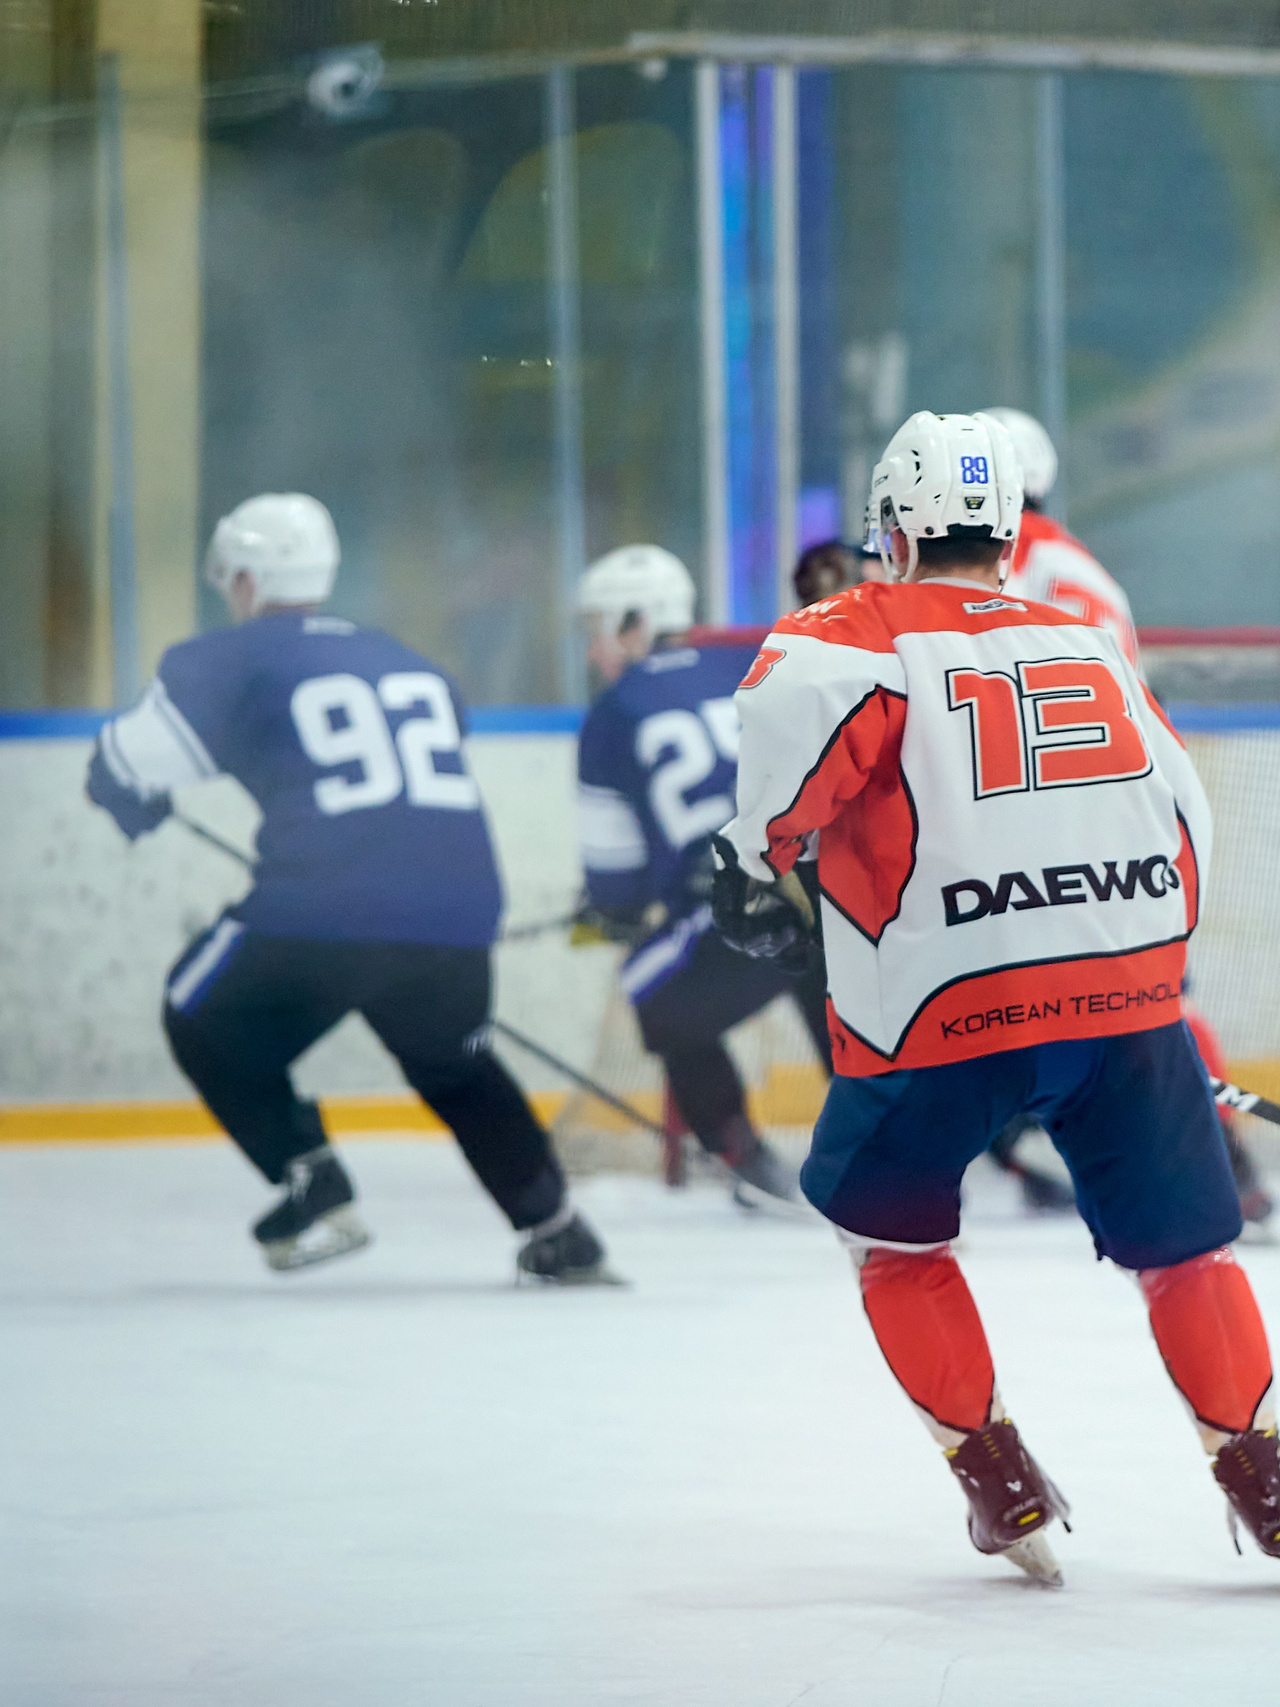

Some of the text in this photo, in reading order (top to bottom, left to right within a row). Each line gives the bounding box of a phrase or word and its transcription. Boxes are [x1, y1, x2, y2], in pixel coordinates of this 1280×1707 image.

[961, 456, 988, 484] 89
[290, 672, 480, 817] 92
[945, 657, 1154, 801] 13
[941, 999, 1061, 1039] KOREAN
